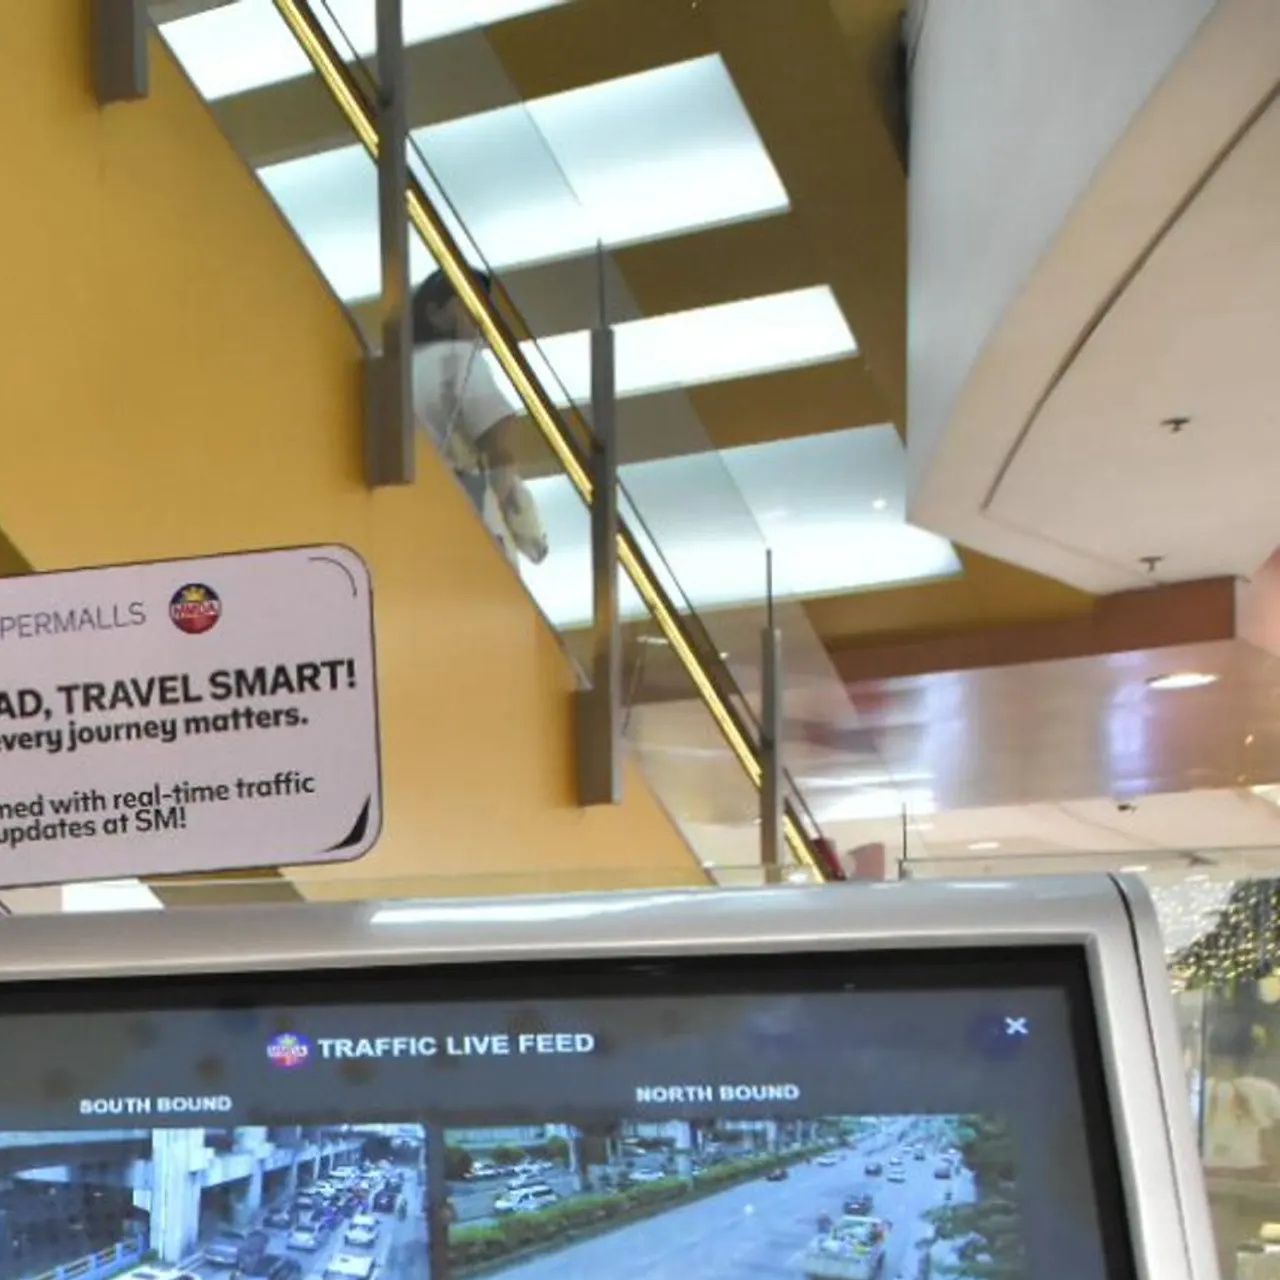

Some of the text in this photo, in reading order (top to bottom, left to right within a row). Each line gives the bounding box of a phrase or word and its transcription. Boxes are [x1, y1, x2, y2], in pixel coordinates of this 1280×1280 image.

[57, 673, 203, 715] TRAVEL
[209, 658, 356, 700] SMART!
[67, 717, 177, 751] journey
[185, 705, 309, 735] matters.
[50, 788, 106, 815] with
[113, 781, 229, 811] real-time
[236, 770, 315, 800] traffic
[103, 813, 129, 836] at
[135, 806, 187, 833] SM!
[317, 1036, 437, 1059] TRAFFIC
[446, 1034, 509, 1056] LIVE
[518, 1033, 595, 1053] FEED
[79, 1095, 233, 1114] SOUTH BOUND
[635, 1083, 801, 1103] NORTH BOUND
